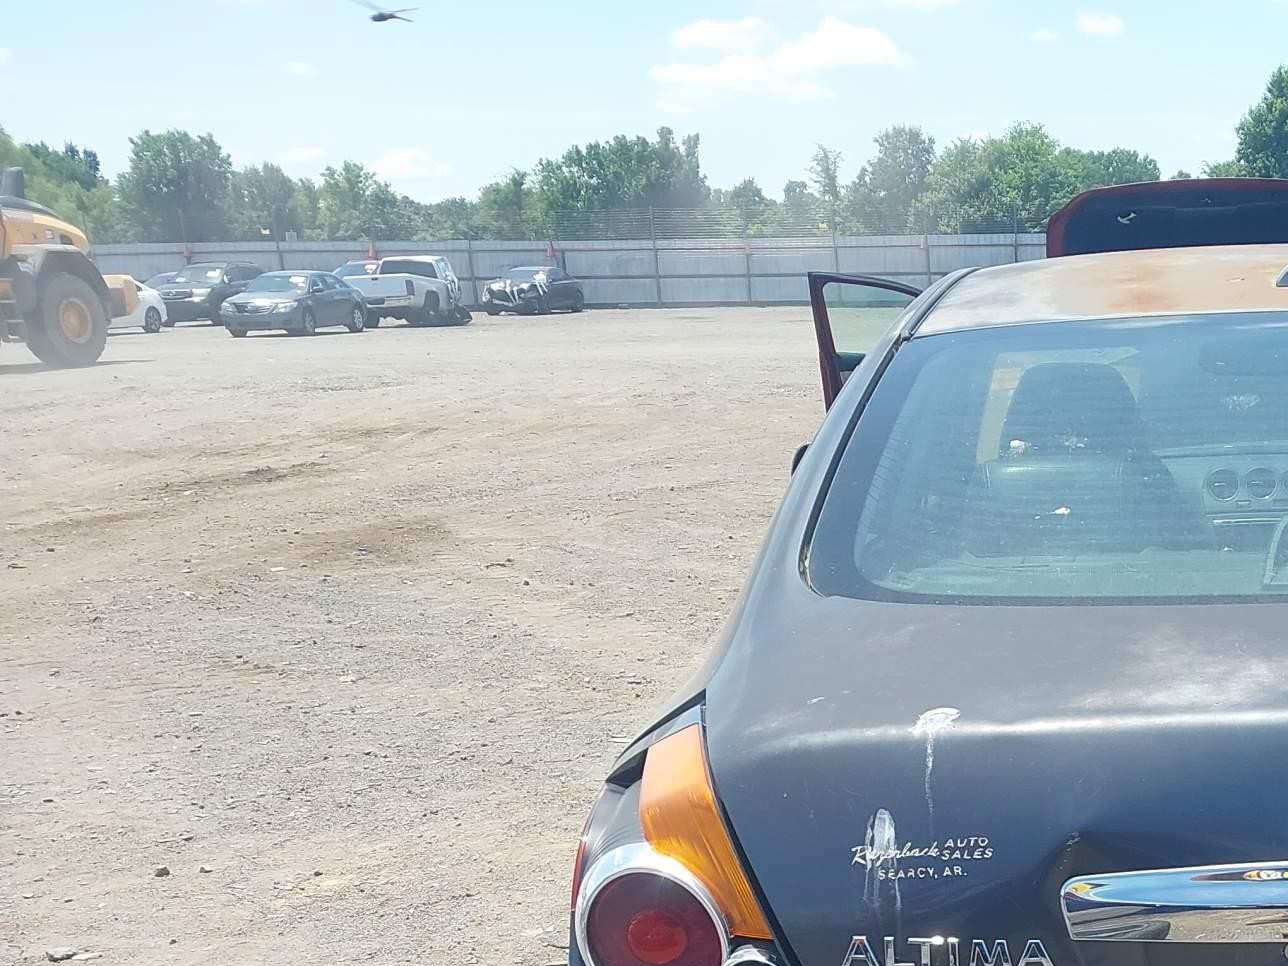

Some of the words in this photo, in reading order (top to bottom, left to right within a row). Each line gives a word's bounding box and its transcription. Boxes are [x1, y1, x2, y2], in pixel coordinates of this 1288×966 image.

[945, 836, 990, 848] AUTO
[941, 847, 994, 860] SALES
[878, 868, 938, 881] SEARCY,
[943, 865, 968, 877] AR.
